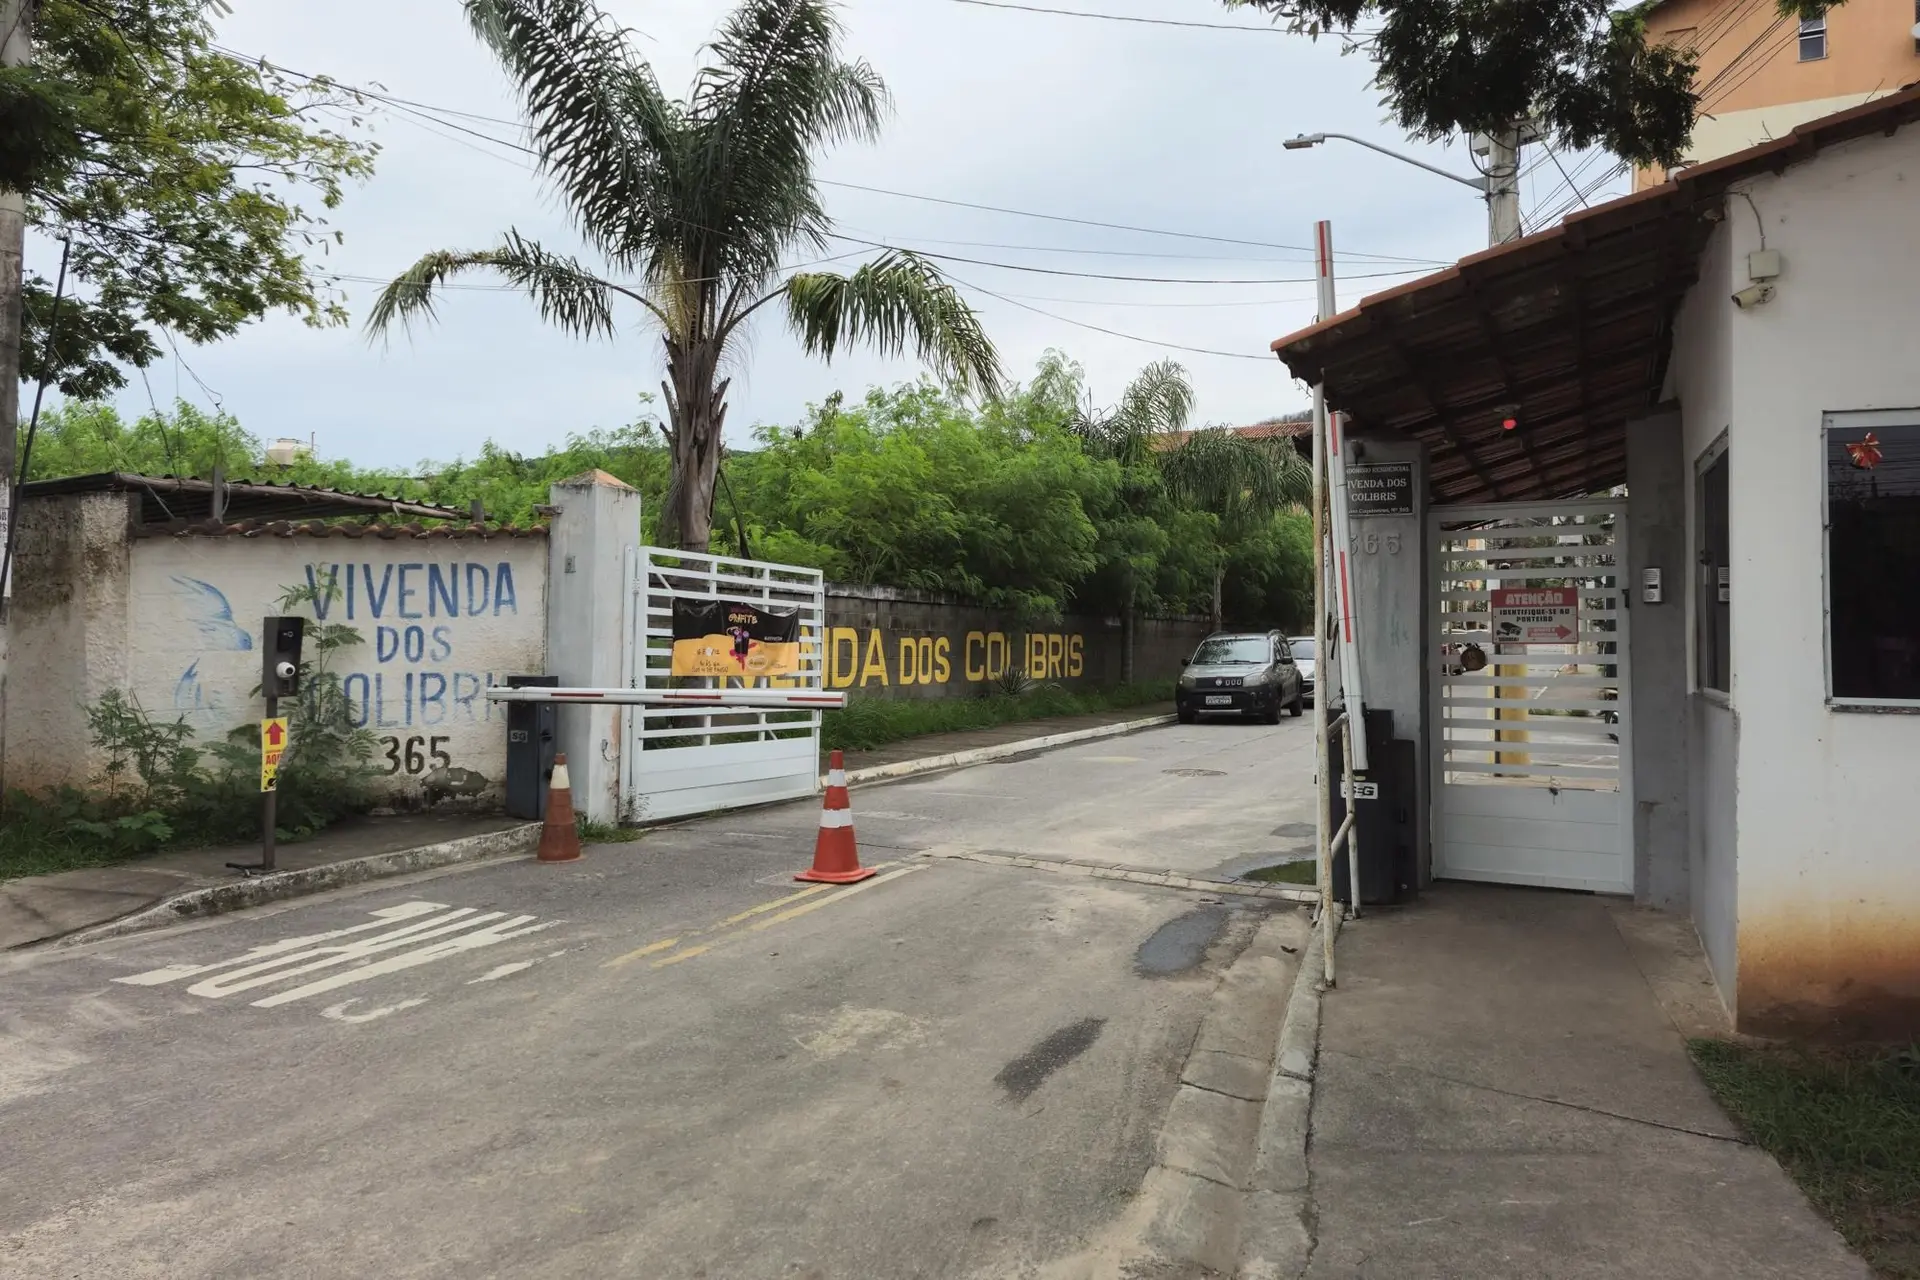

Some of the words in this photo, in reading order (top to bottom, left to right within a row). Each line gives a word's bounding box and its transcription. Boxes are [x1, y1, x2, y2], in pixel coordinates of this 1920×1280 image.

[1347, 479, 1384, 489] IVENDA
[1387, 478, 1407, 487] DOS
[1352, 492, 1397, 502] COLIBRIS
[305, 562, 517, 620] VIVENDA
[1505, 590, 1563, 606] ATENÇÃO
[376, 625, 452, 664] DOS
[900, 636, 950, 685] DOS
[379, 735, 451, 775] 365
